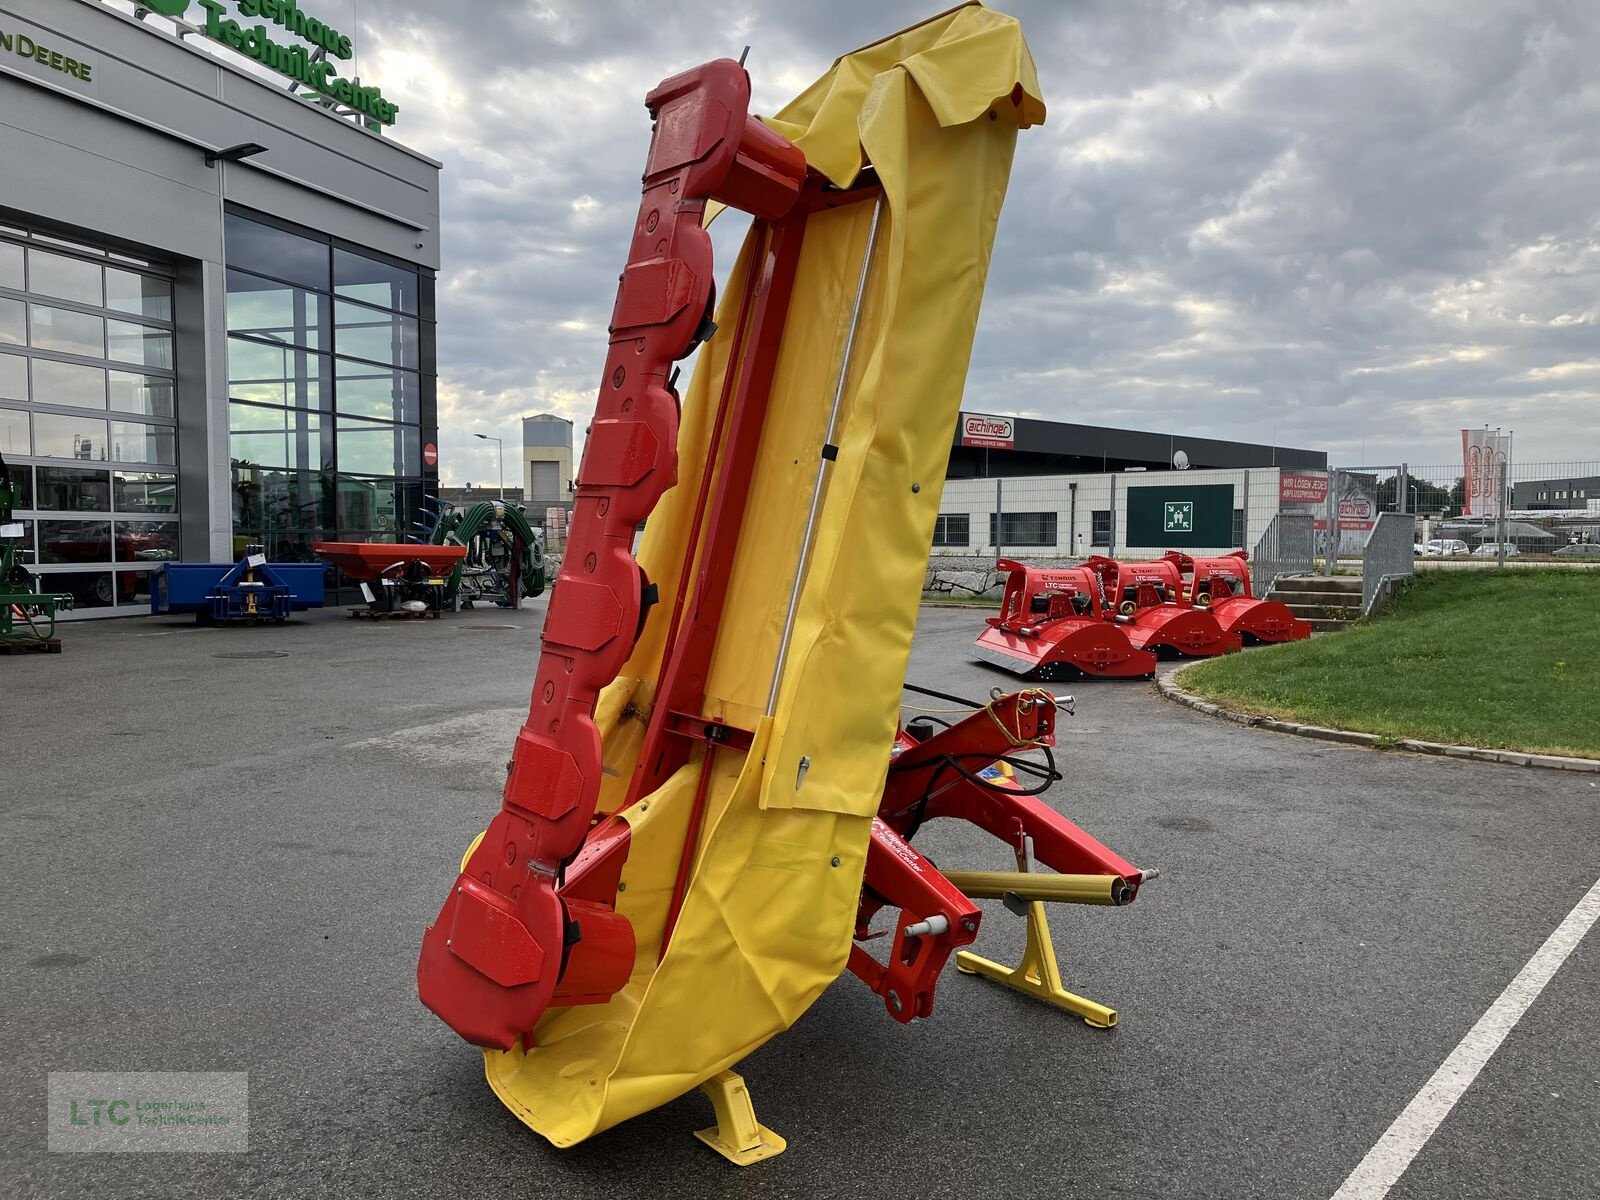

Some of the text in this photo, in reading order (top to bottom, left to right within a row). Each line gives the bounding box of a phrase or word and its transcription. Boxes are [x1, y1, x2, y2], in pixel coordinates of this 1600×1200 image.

[16, 33, 92, 82] DEERE
[198, 0, 399, 125] TechnikCenter
[968, 418, 1009, 436] aichinger
